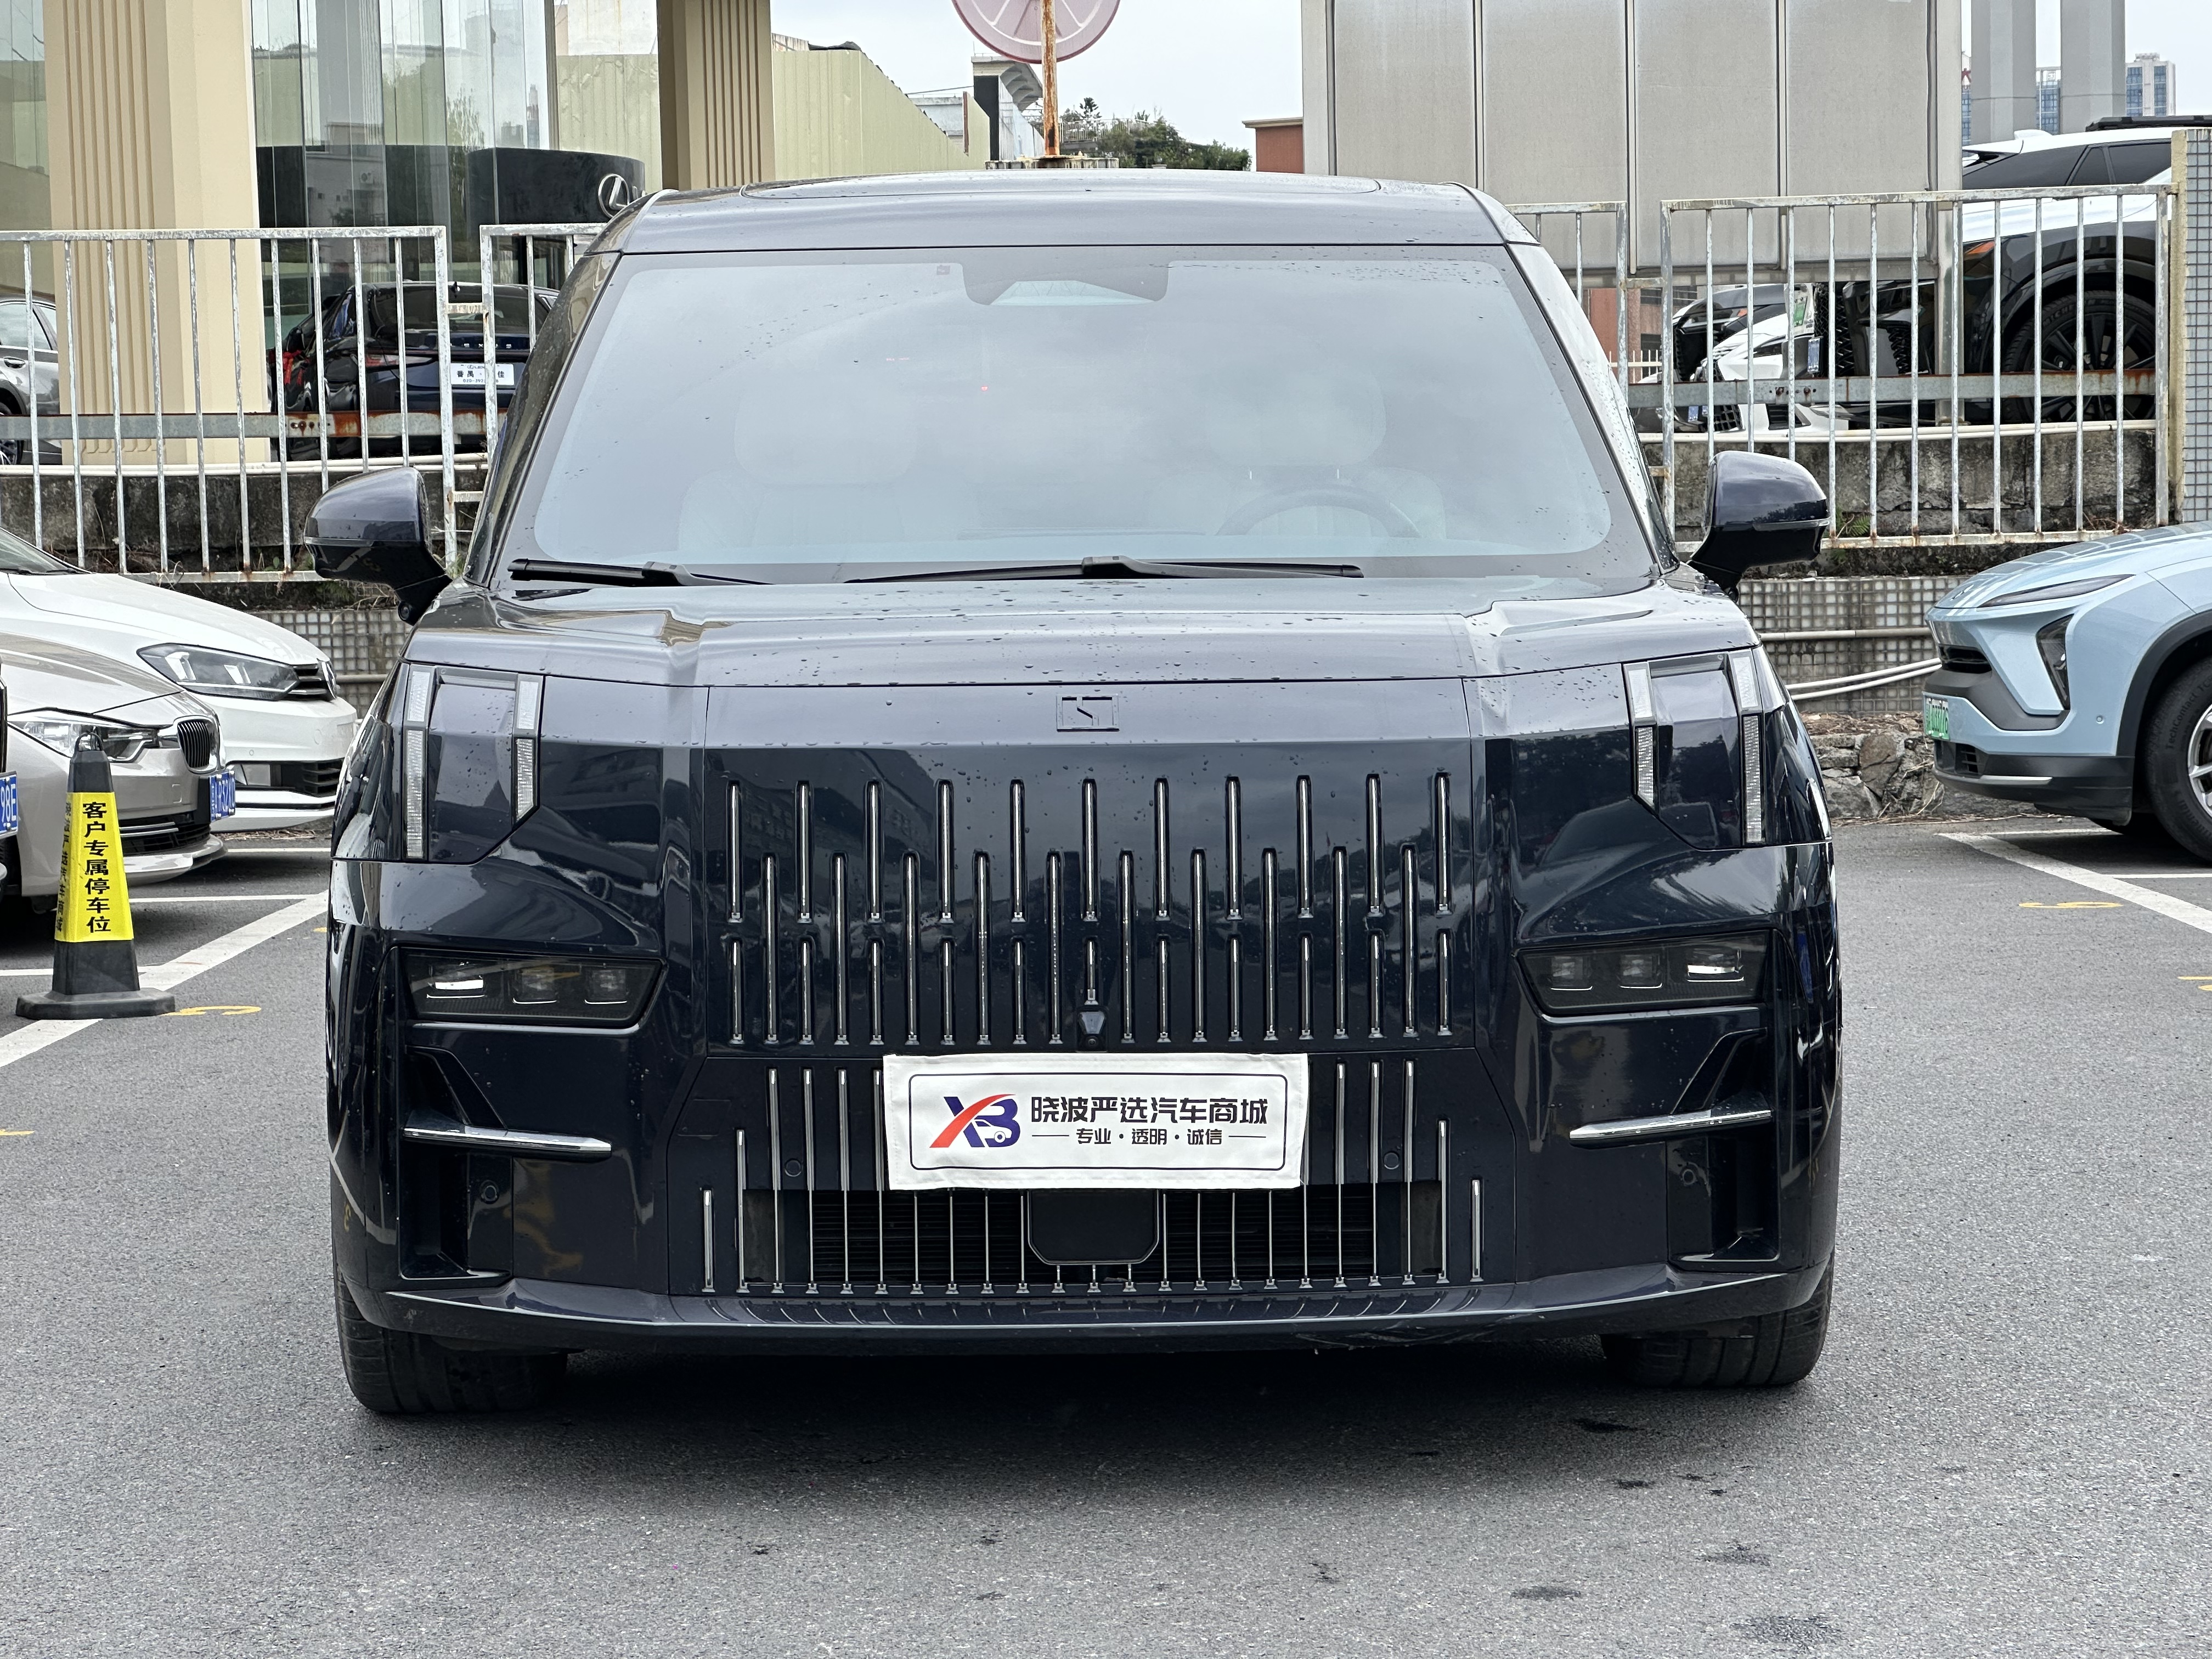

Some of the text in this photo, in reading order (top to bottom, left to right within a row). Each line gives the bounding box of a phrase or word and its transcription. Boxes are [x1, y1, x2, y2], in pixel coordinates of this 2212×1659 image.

[456, 370, 505, 378] 番禺·佳
[83, 802, 111, 933] 客户专属停车位
[1031, 1096, 1268, 1124] 晓波严选汽车商城
